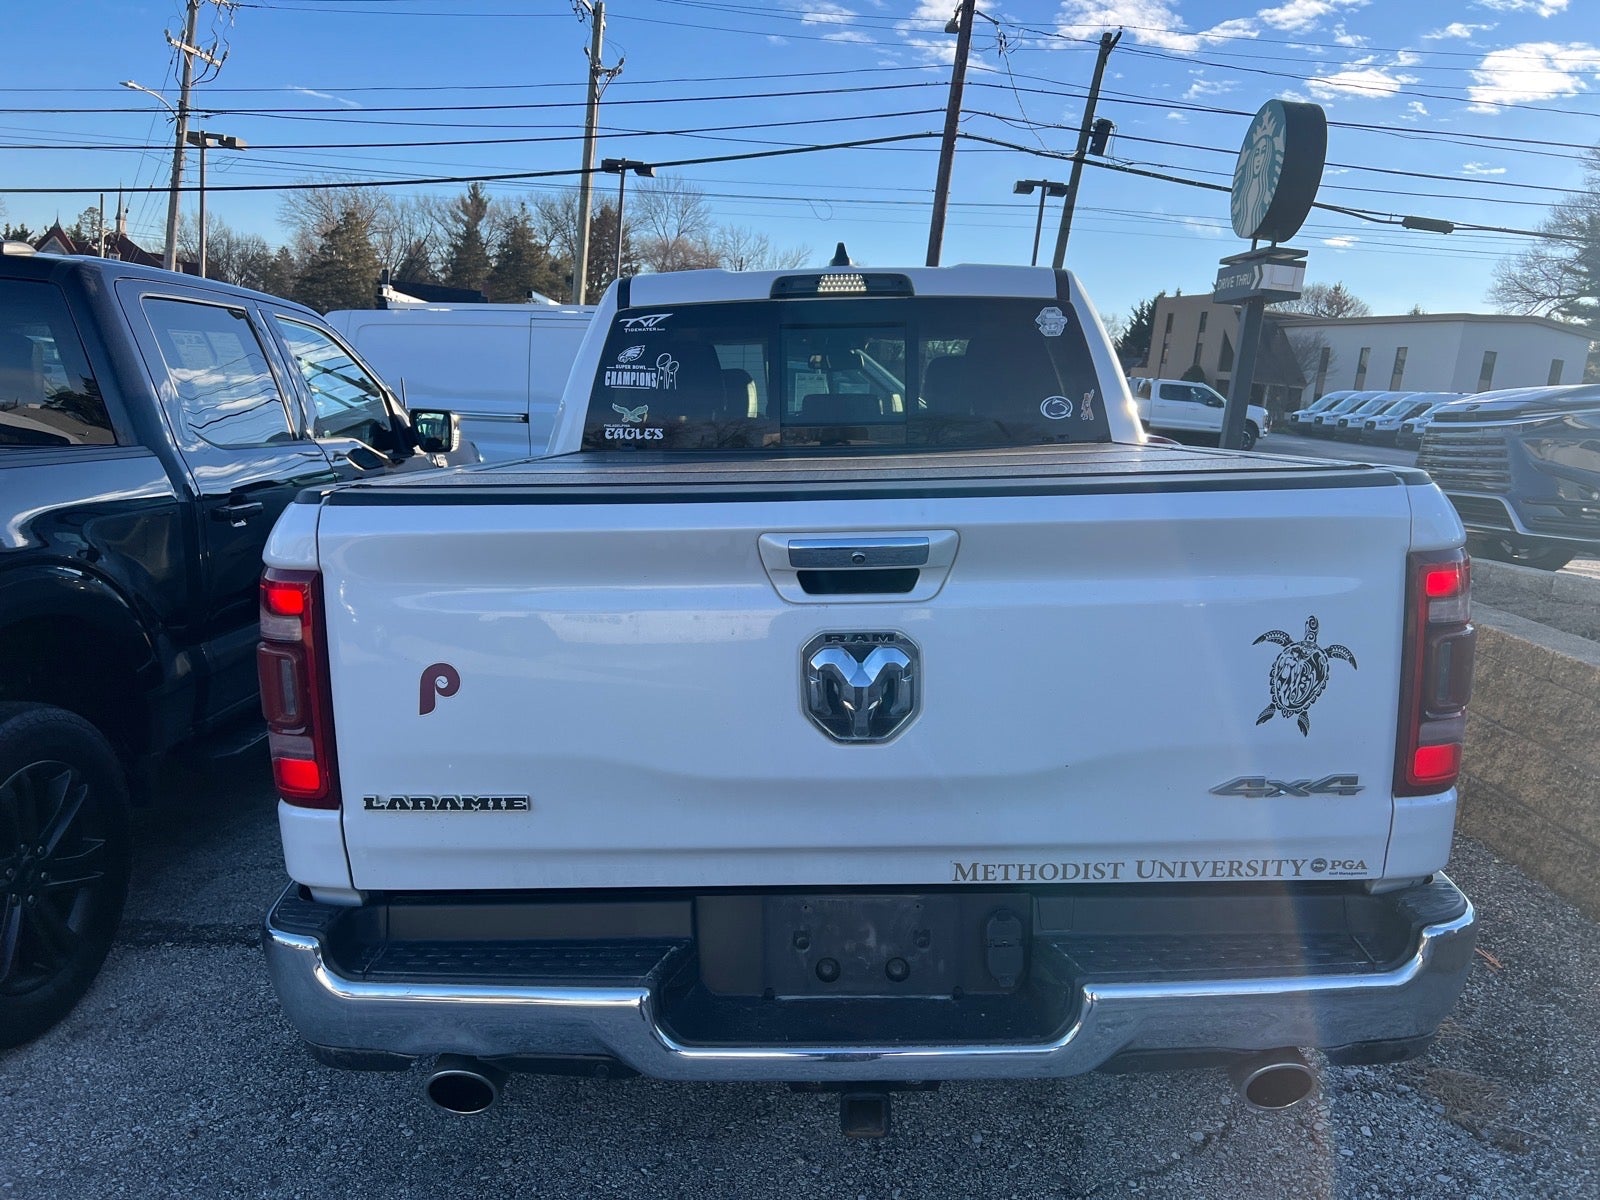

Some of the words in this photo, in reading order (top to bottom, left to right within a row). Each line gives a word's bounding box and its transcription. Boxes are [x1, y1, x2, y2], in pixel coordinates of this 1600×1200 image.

[1217, 276, 1234, 290] DRIVE
[1236, 273, 1252, 287] THRU
[604, 371, 657, 388] CHAMPIONS
[604, 427, 664, 440] EAGLES
[825, 632, 895, 643] RAM
[363, 794, 531, 812] LARAMIE
[951, 861, 1125, 882] METHODIST
[1135, 858, 1308, 879] UNIVERSITY
[1329, 859, 1368, 870] PGA
